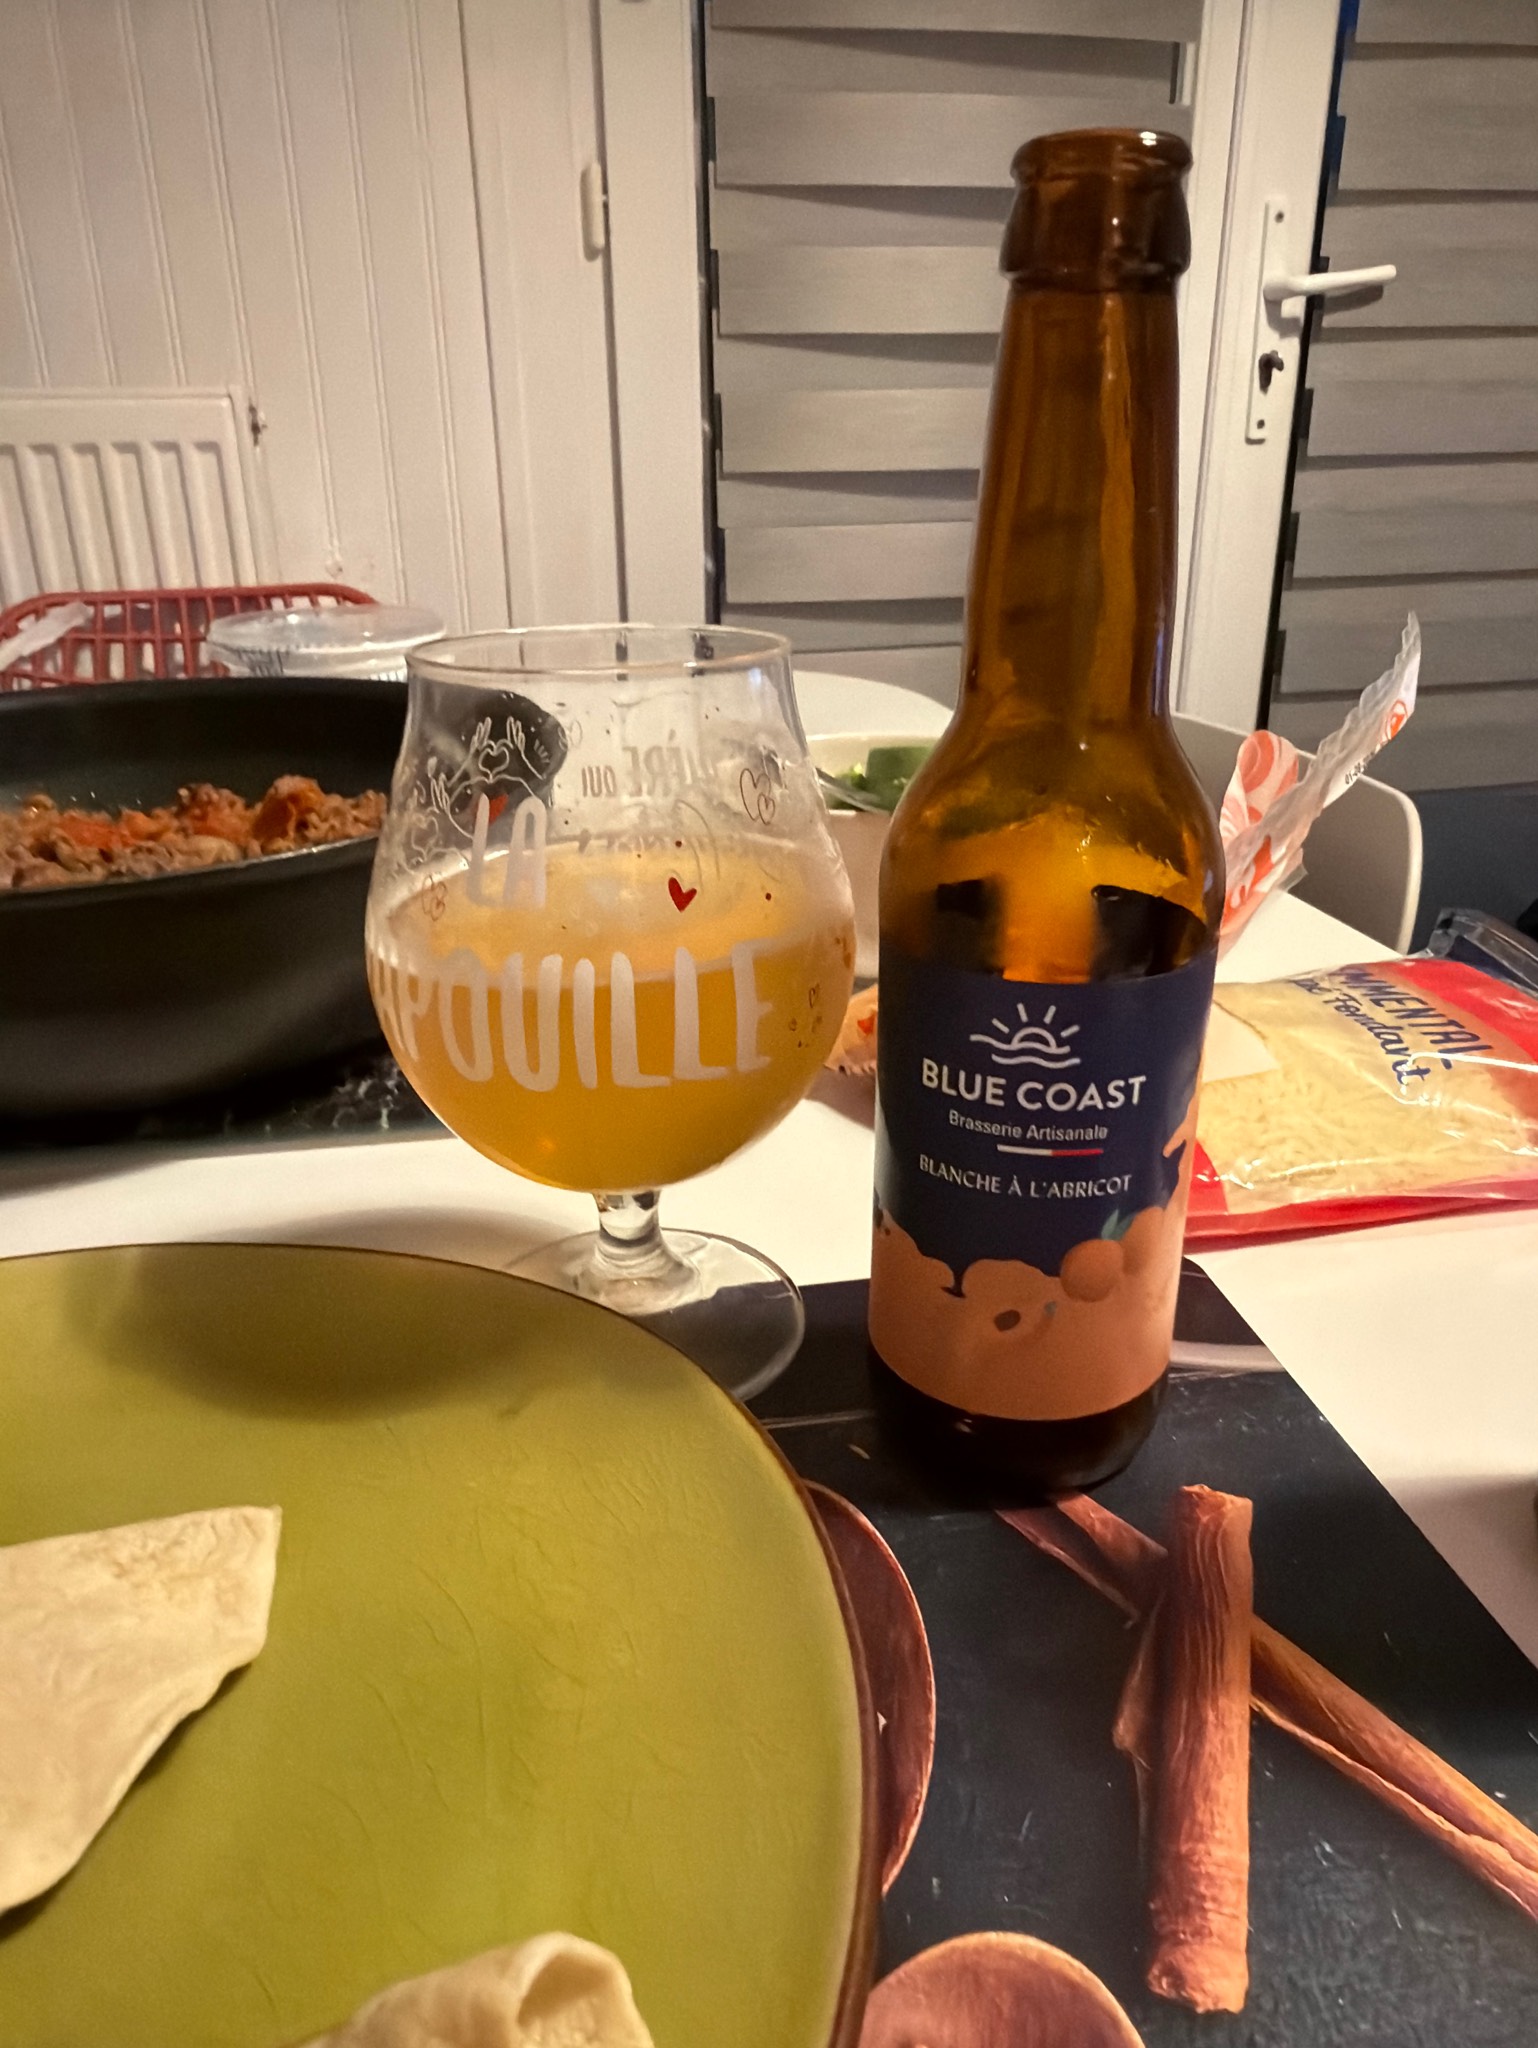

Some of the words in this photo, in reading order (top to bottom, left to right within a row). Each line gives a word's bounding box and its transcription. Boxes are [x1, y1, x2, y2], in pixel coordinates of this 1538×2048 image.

[467, 792, 548, 910] LA
[921, 1056, 1008, 1108] BLUE
[1015, 1074, 1148, 1113] COAST
[948, 1108, 1023, 1140] Brasserie
[1026, 1123, 1109, 1143] Artisanale
[918, 1153, 1001, 1195] BLANCHE
[1007, 1174, 1023, 1198] À
[1029, 1173, 1133, 1200] L'ABRICOT
